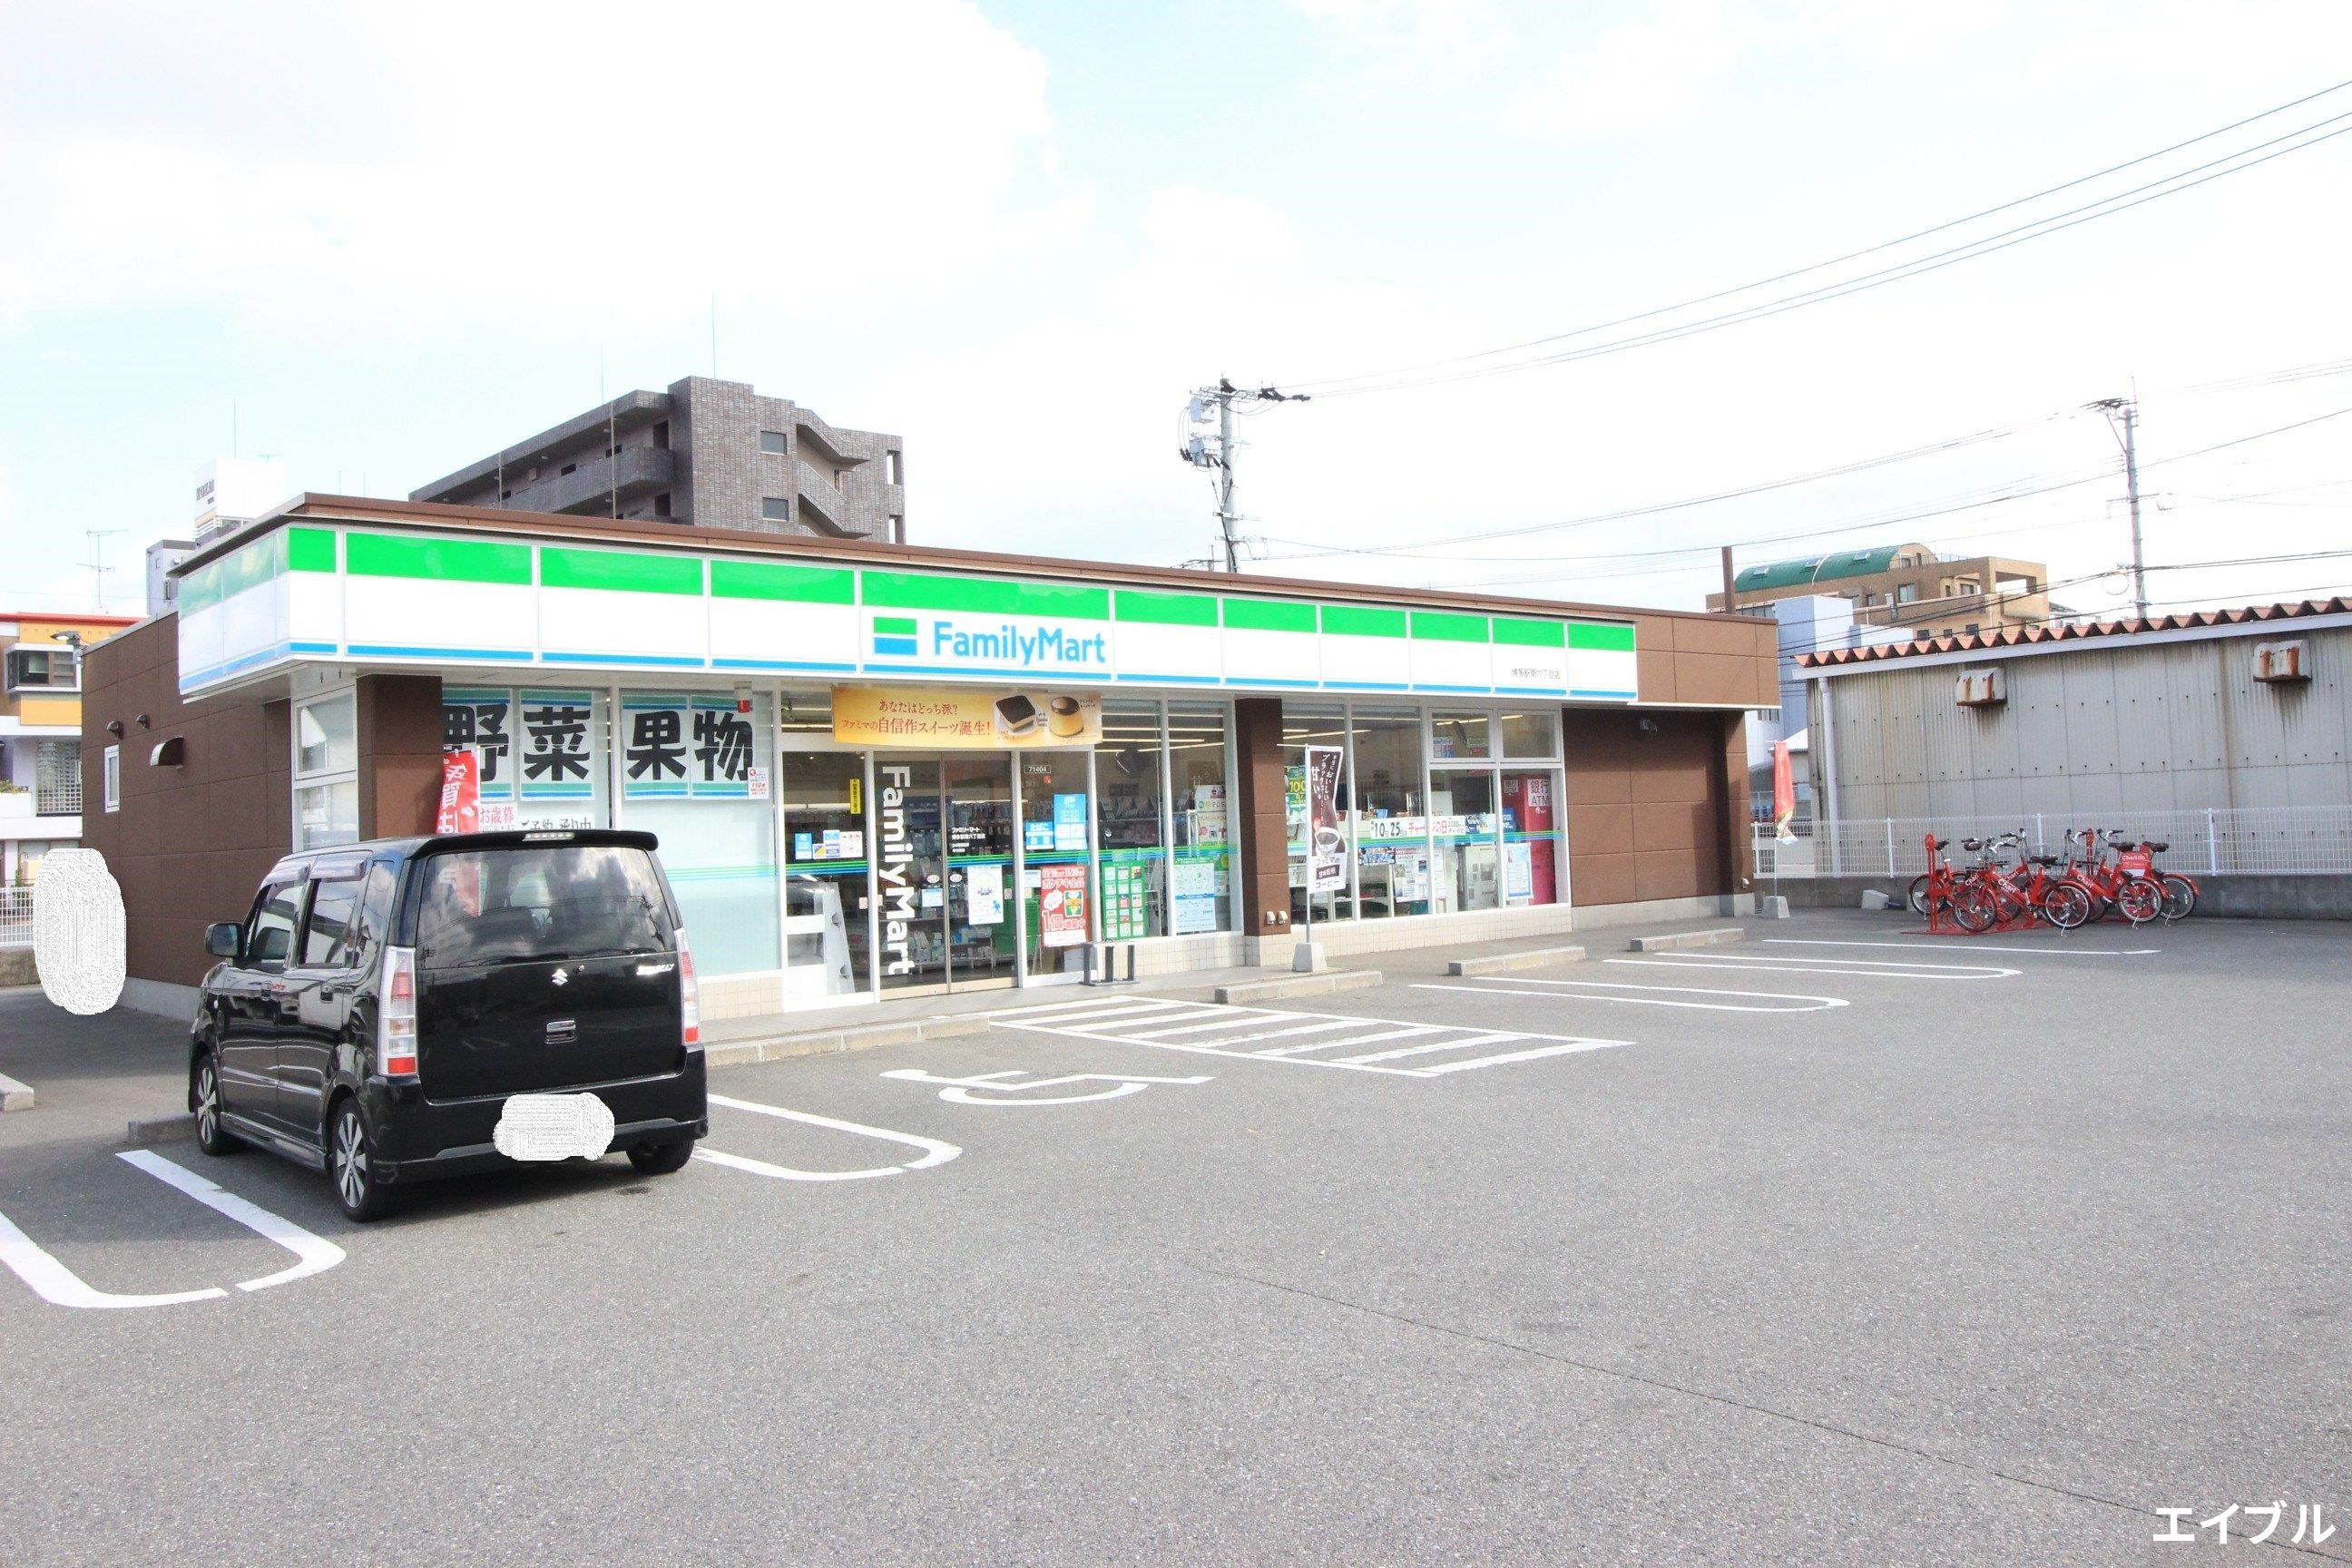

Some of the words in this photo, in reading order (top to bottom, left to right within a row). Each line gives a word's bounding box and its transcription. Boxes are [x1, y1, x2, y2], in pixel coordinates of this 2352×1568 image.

[933, 621, 1106, 666] FamilyMart
[443, 704, 591, 781] 野菜
[626, 710, 754, 781] 果物
[878, 766, 916, 976] FamilyMart
